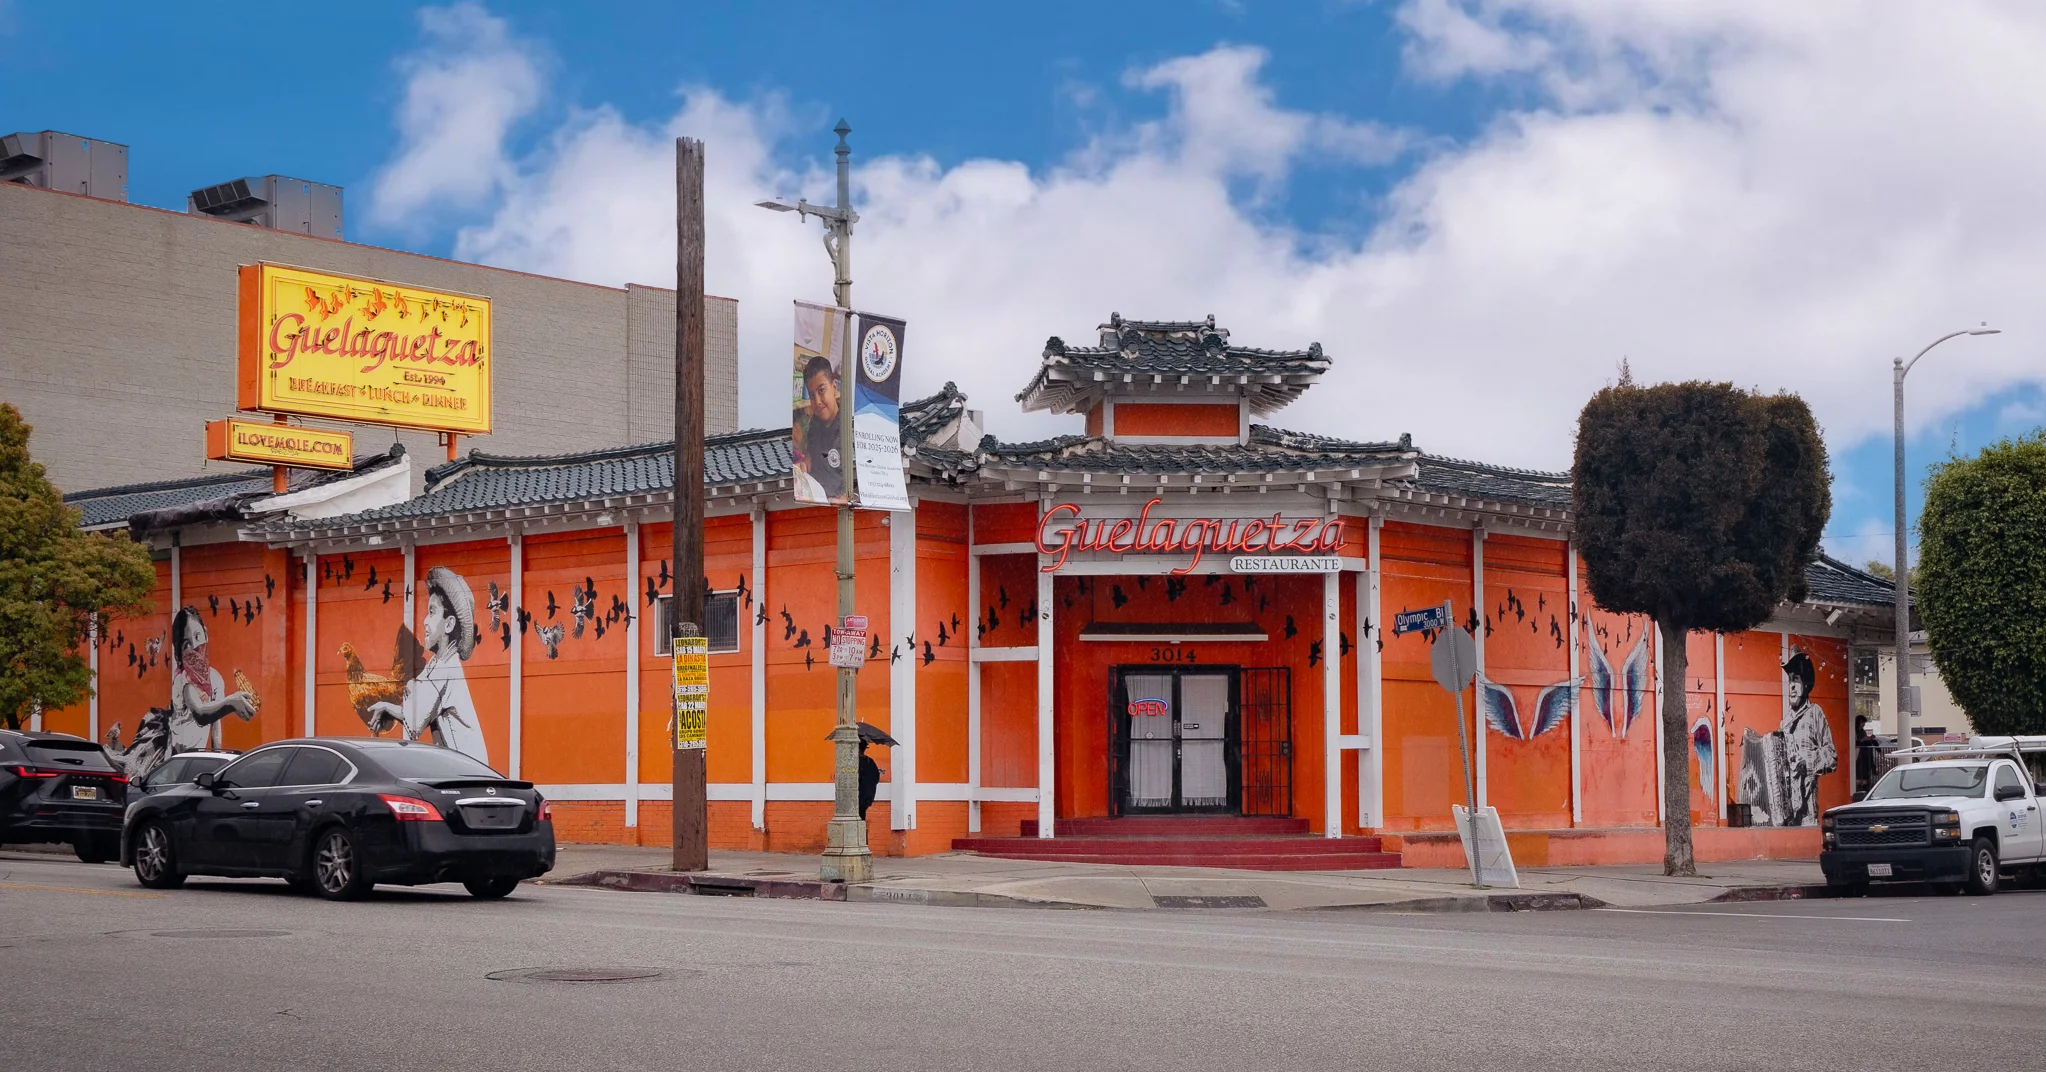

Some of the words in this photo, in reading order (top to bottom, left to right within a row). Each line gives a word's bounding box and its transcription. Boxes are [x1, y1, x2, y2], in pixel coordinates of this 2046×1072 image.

[269, 313, 484, 373] Guelaguetza
[865, 333, 876, 350] VISTA
[876, 330, 894, 355] HORIZON
[404, 371, 421, 383] Est.
[290, 377, 357, 398] BREAKFAST
[369, 386, 411, 405] LUNCH
[422, 393, 468, 410] DINNER
[238, 432, 344, 456] ILOVEMOLE.COM
[855, 431, 885, 442] ENROLLING
[885, 436, 899, 444] NOW
[857, 441, 867, 450] FOR
[868, 443, 899, 454] 2025-2026
[1035, 498, 1349, 574] Guelaguetza
[1234, 558, 1340, 571] RESTAURANTE
[1397, 612, 1429, 627] Olympic
[1423, 619, 1437, 629] 3000
[1440, 617, 1445, 625] W
[833, 628, 866, 637] TOW-AWAY
[831, 635, 841, 645] NO
[842, 636, 865, 646] STOPPING
[1150, 648, 1197, 663] 3014
[1128, 702, 1166, 716] OPEN
